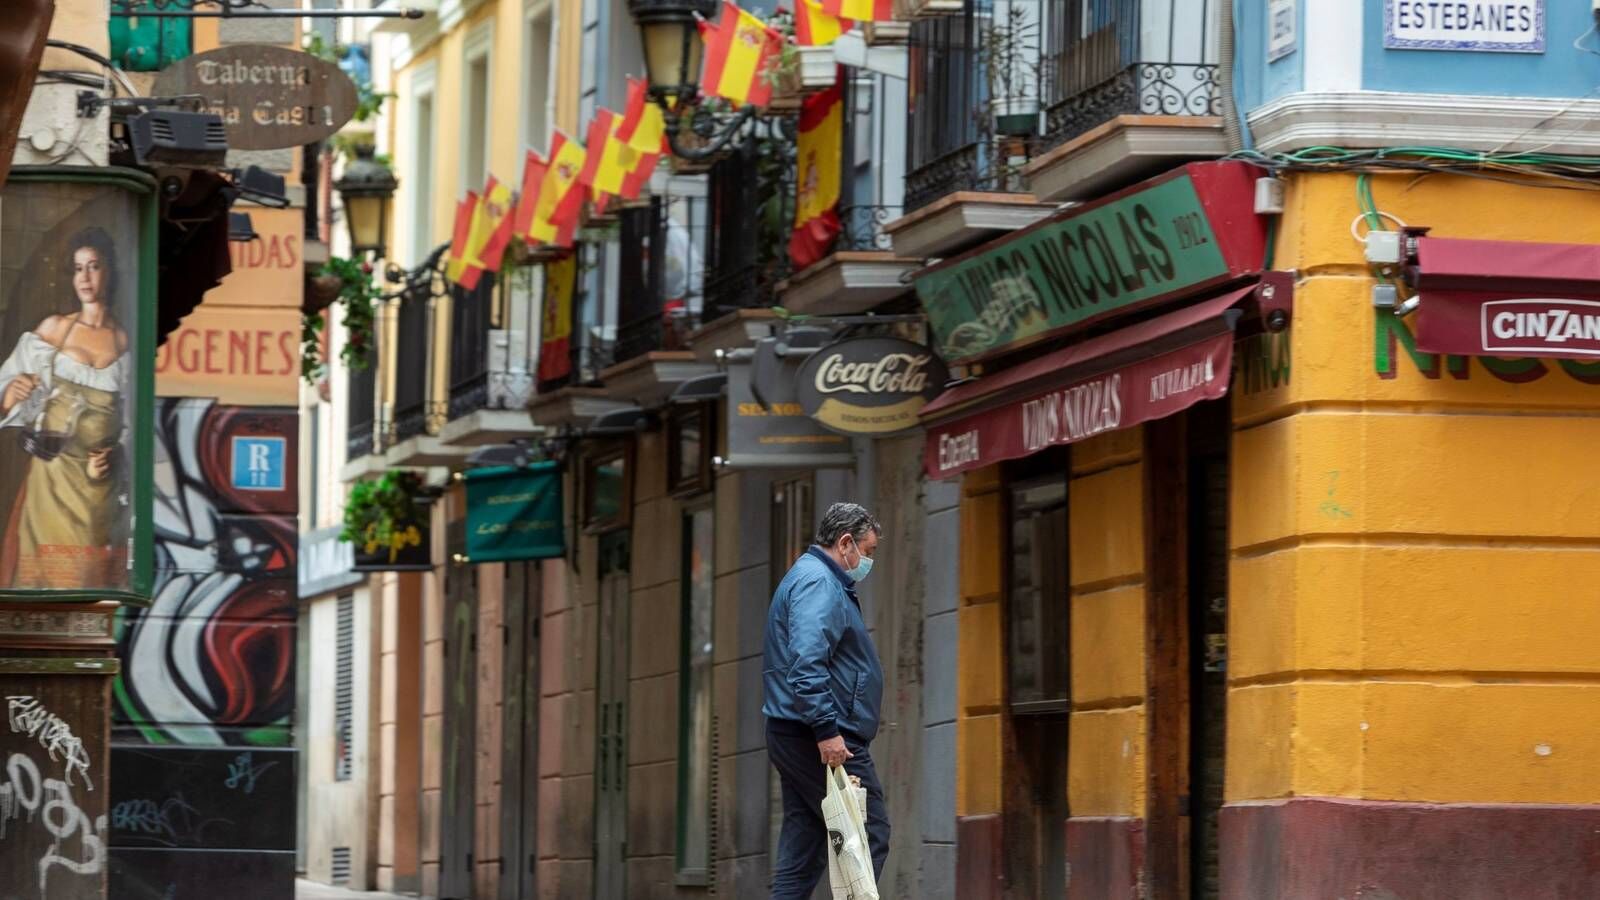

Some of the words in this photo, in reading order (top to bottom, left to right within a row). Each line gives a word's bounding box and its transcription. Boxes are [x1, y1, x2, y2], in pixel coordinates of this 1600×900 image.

[1399, 2, 1531, 32] ESTEBANES
[196, 59, 311, 86] Taberna
[1031, 204, 1175, 314] NICOLAS
[1492, 309, 1600, 342] CINZAN
[815, 353, 932, 394] Coca-Cola
[248, 443, 272, 472] R
